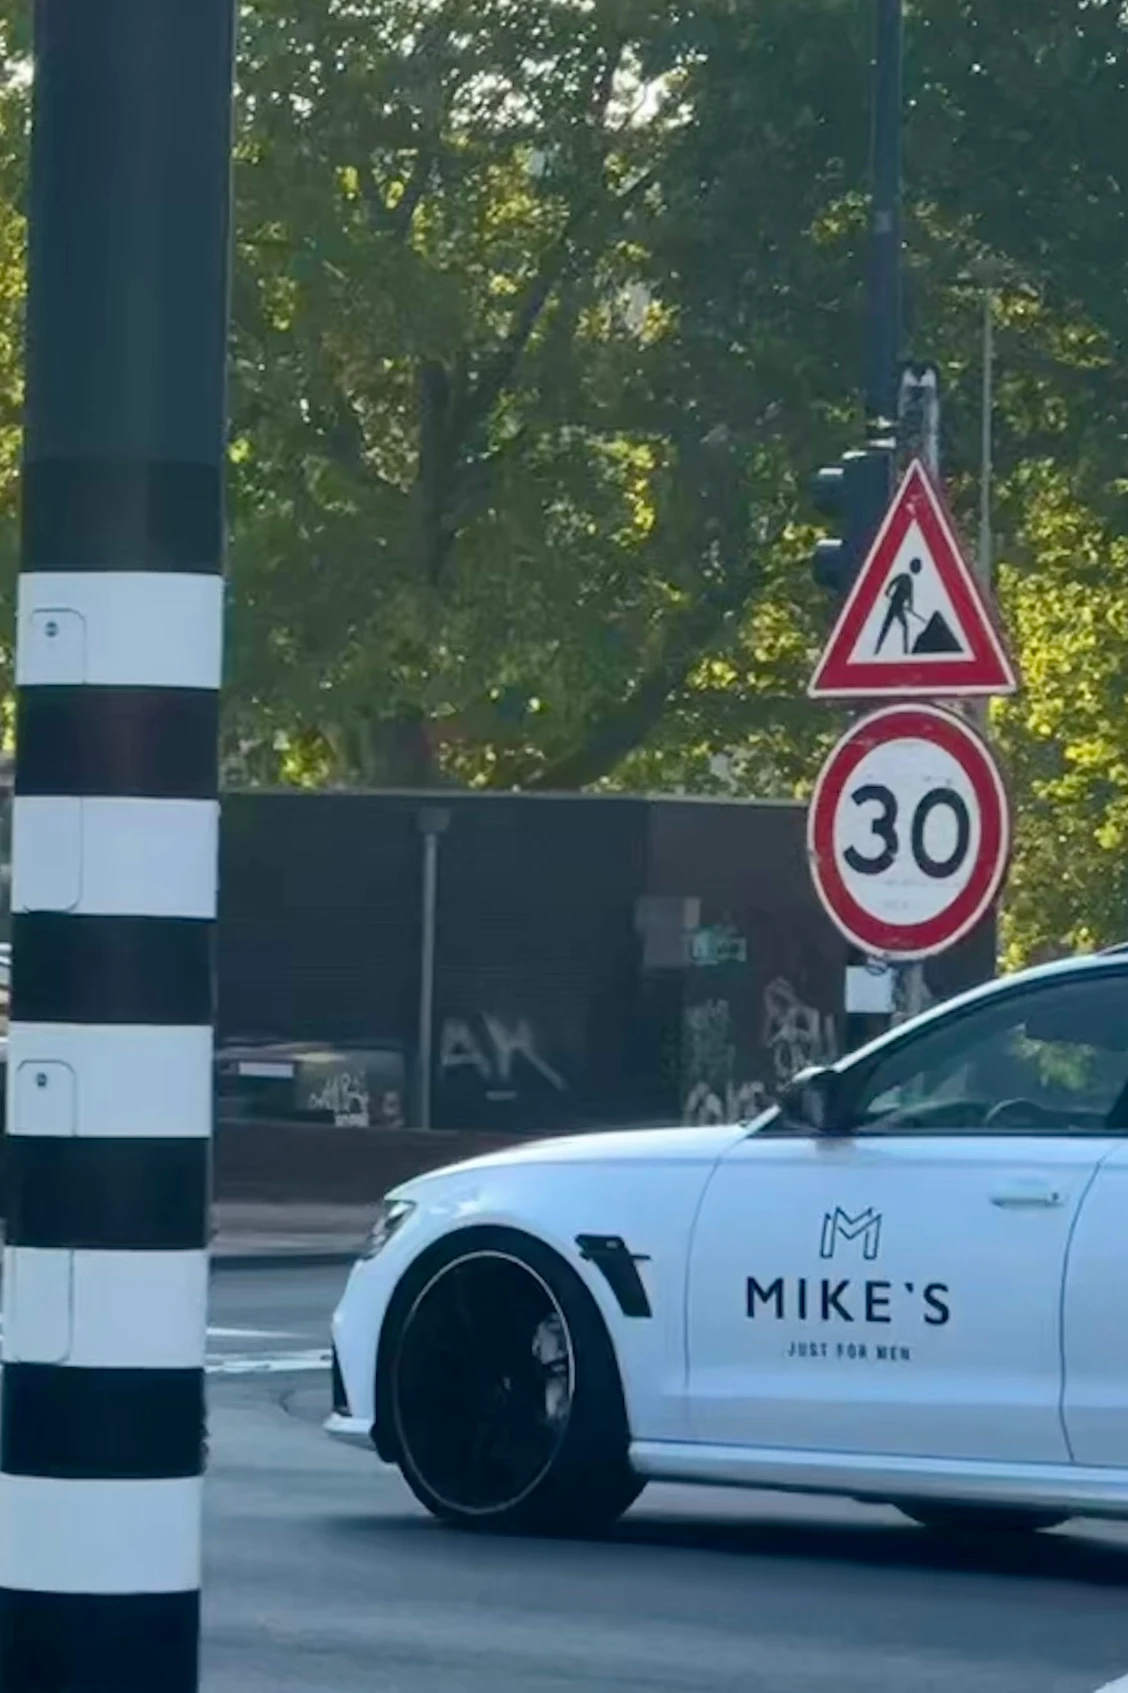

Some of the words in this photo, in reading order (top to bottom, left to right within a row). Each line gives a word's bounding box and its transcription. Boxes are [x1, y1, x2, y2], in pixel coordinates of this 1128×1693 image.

[843, 783, 971, 879] 30
[746, 1275, 951, 1326] MIKE'S
[788, 1341, 828, 1358] JUST
[837, 1343, 867, 1360] FOR
[876, 1345, 911, 1361] MEN
